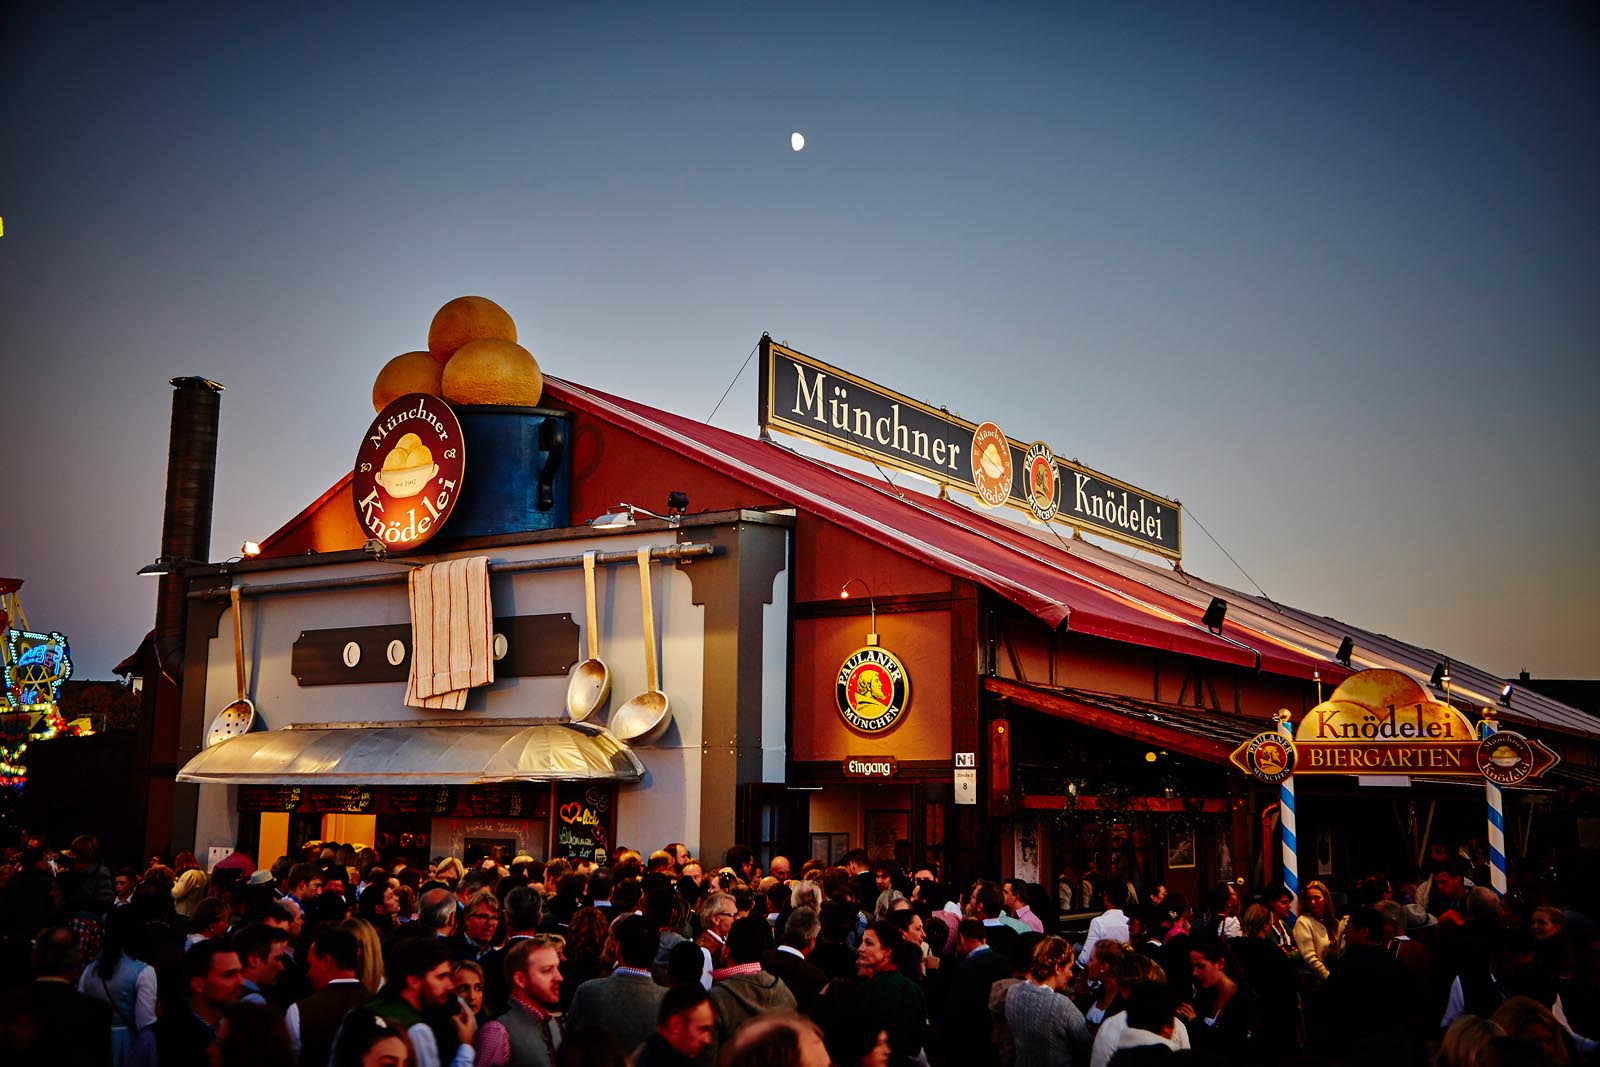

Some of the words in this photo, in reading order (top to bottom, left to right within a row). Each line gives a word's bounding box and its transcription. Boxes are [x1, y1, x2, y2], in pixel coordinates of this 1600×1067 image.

[369, 399, 449, 450] Münchner
[791, 363, 960, 471] Münchner
[977, 428, 1007, 456] Münchner
[1024, 444, 1059, 481] PAULANER
[975, 465, 1012, 503] Knödelei
[358, 477, 457, 543] Knödelei
[1074, 472, 1163, 541] Knödelei
[838, 650, 902, 687] PAULANER
[844, 704, 900, 730] MÜNCHEN
[1315, 704, 1454, 740] Knödelei
[1249, 734, 1293, 754] PAULANER
[1310, 748, 1461, 768] BIERGARTEN
[1484, 735, 1524, 750] Münchner
[848, 760, 891, 777] Eingang
[1482, 762, 1530, 782] Knödelei
[962, 782, 968, 791] 8
